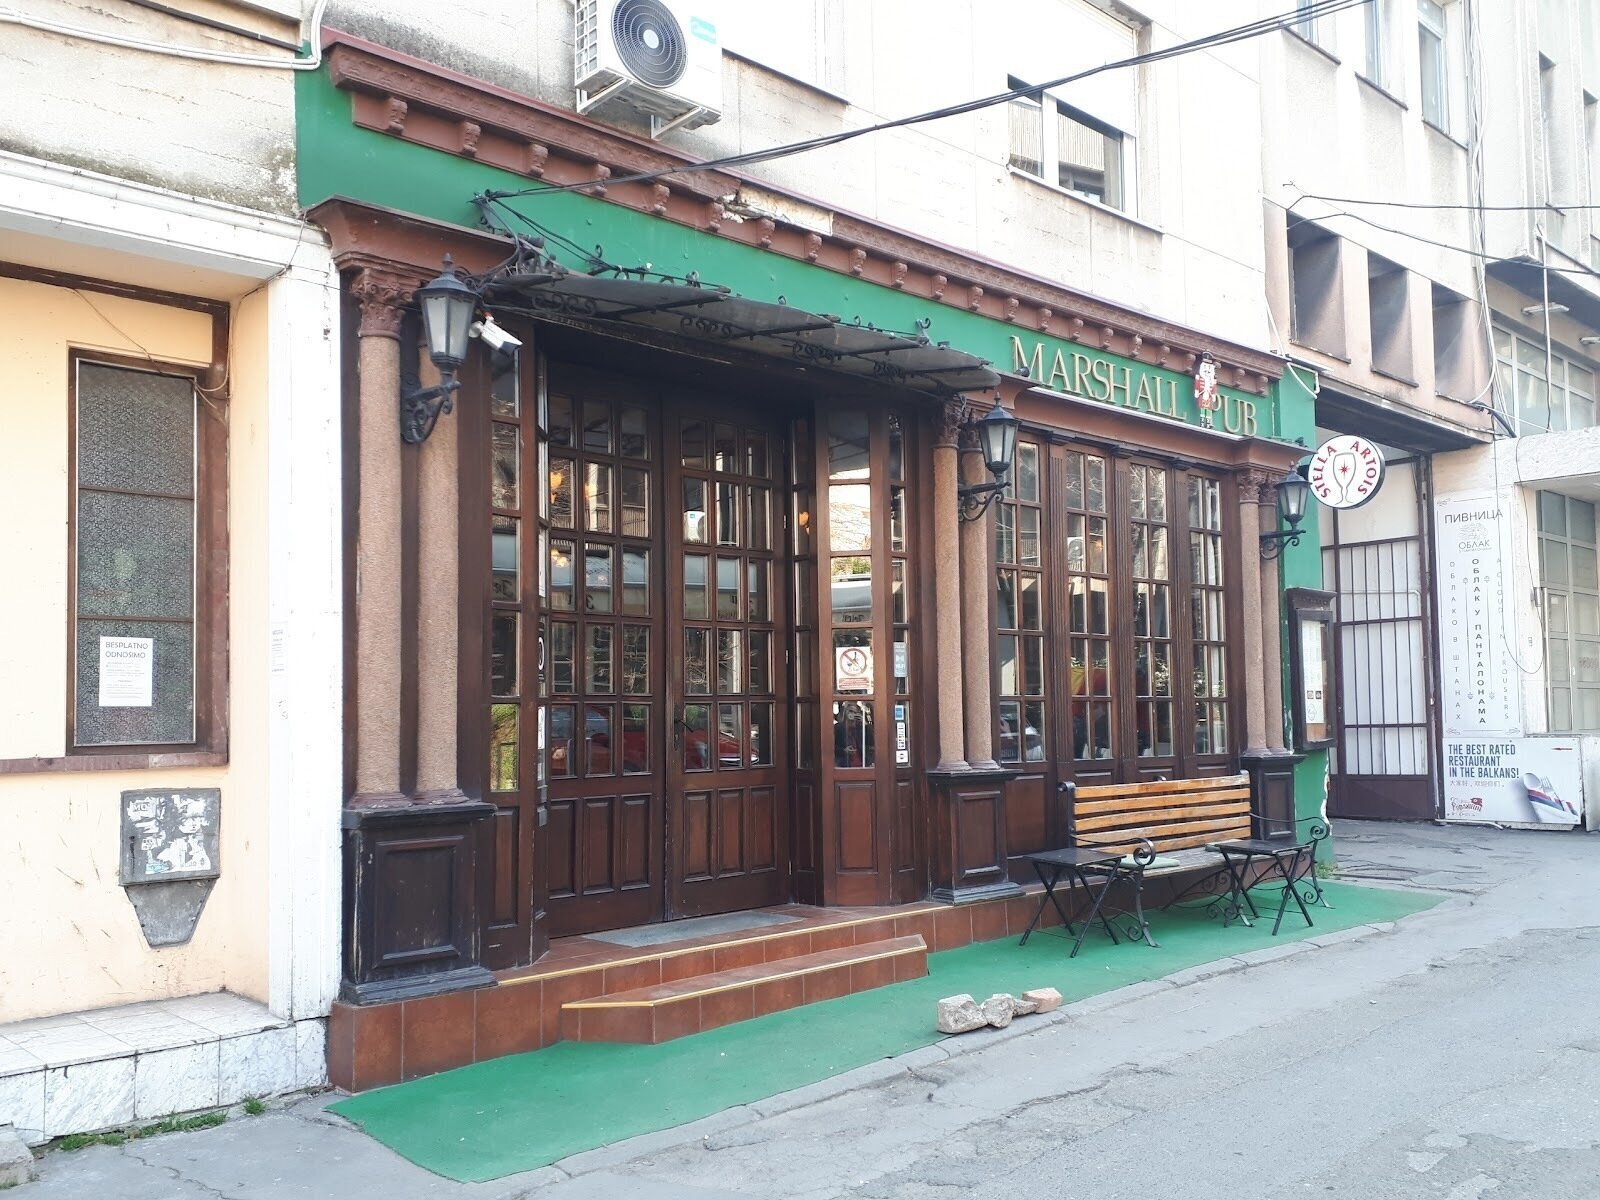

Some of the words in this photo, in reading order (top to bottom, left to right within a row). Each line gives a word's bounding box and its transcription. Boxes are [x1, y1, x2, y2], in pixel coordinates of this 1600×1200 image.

[1010, 335, 1187, 421] MARSHALL
[1209, 393, 1257, 437] PUB
[1312, 445, 1338, 498] STELLA
[1350, 441, 1377, 495] ARTOIS
[1444, 508, 1504, 524] ПИВНИЦА
[1458, 539, 1491, 550] ОБЛАК
[105, 641, 149, 650] BESPLATNO
[105, 650, 146, 659] ODNOSIMO
[1474, 624, 1486, 724] ПАНТАЛОНАМА
[1448, 744, 1463, 755] THE
[1466, 744, 1486, 755] BEST
[1489, 744, 1516, 755] RATED
[1448, 755, 1501, 767] RESTAURANT
[1449, 767, 1457, 777] IN
[1460, 767, 1475, 778] THE
[1478, 767, 1520, 779] BALKANS!
